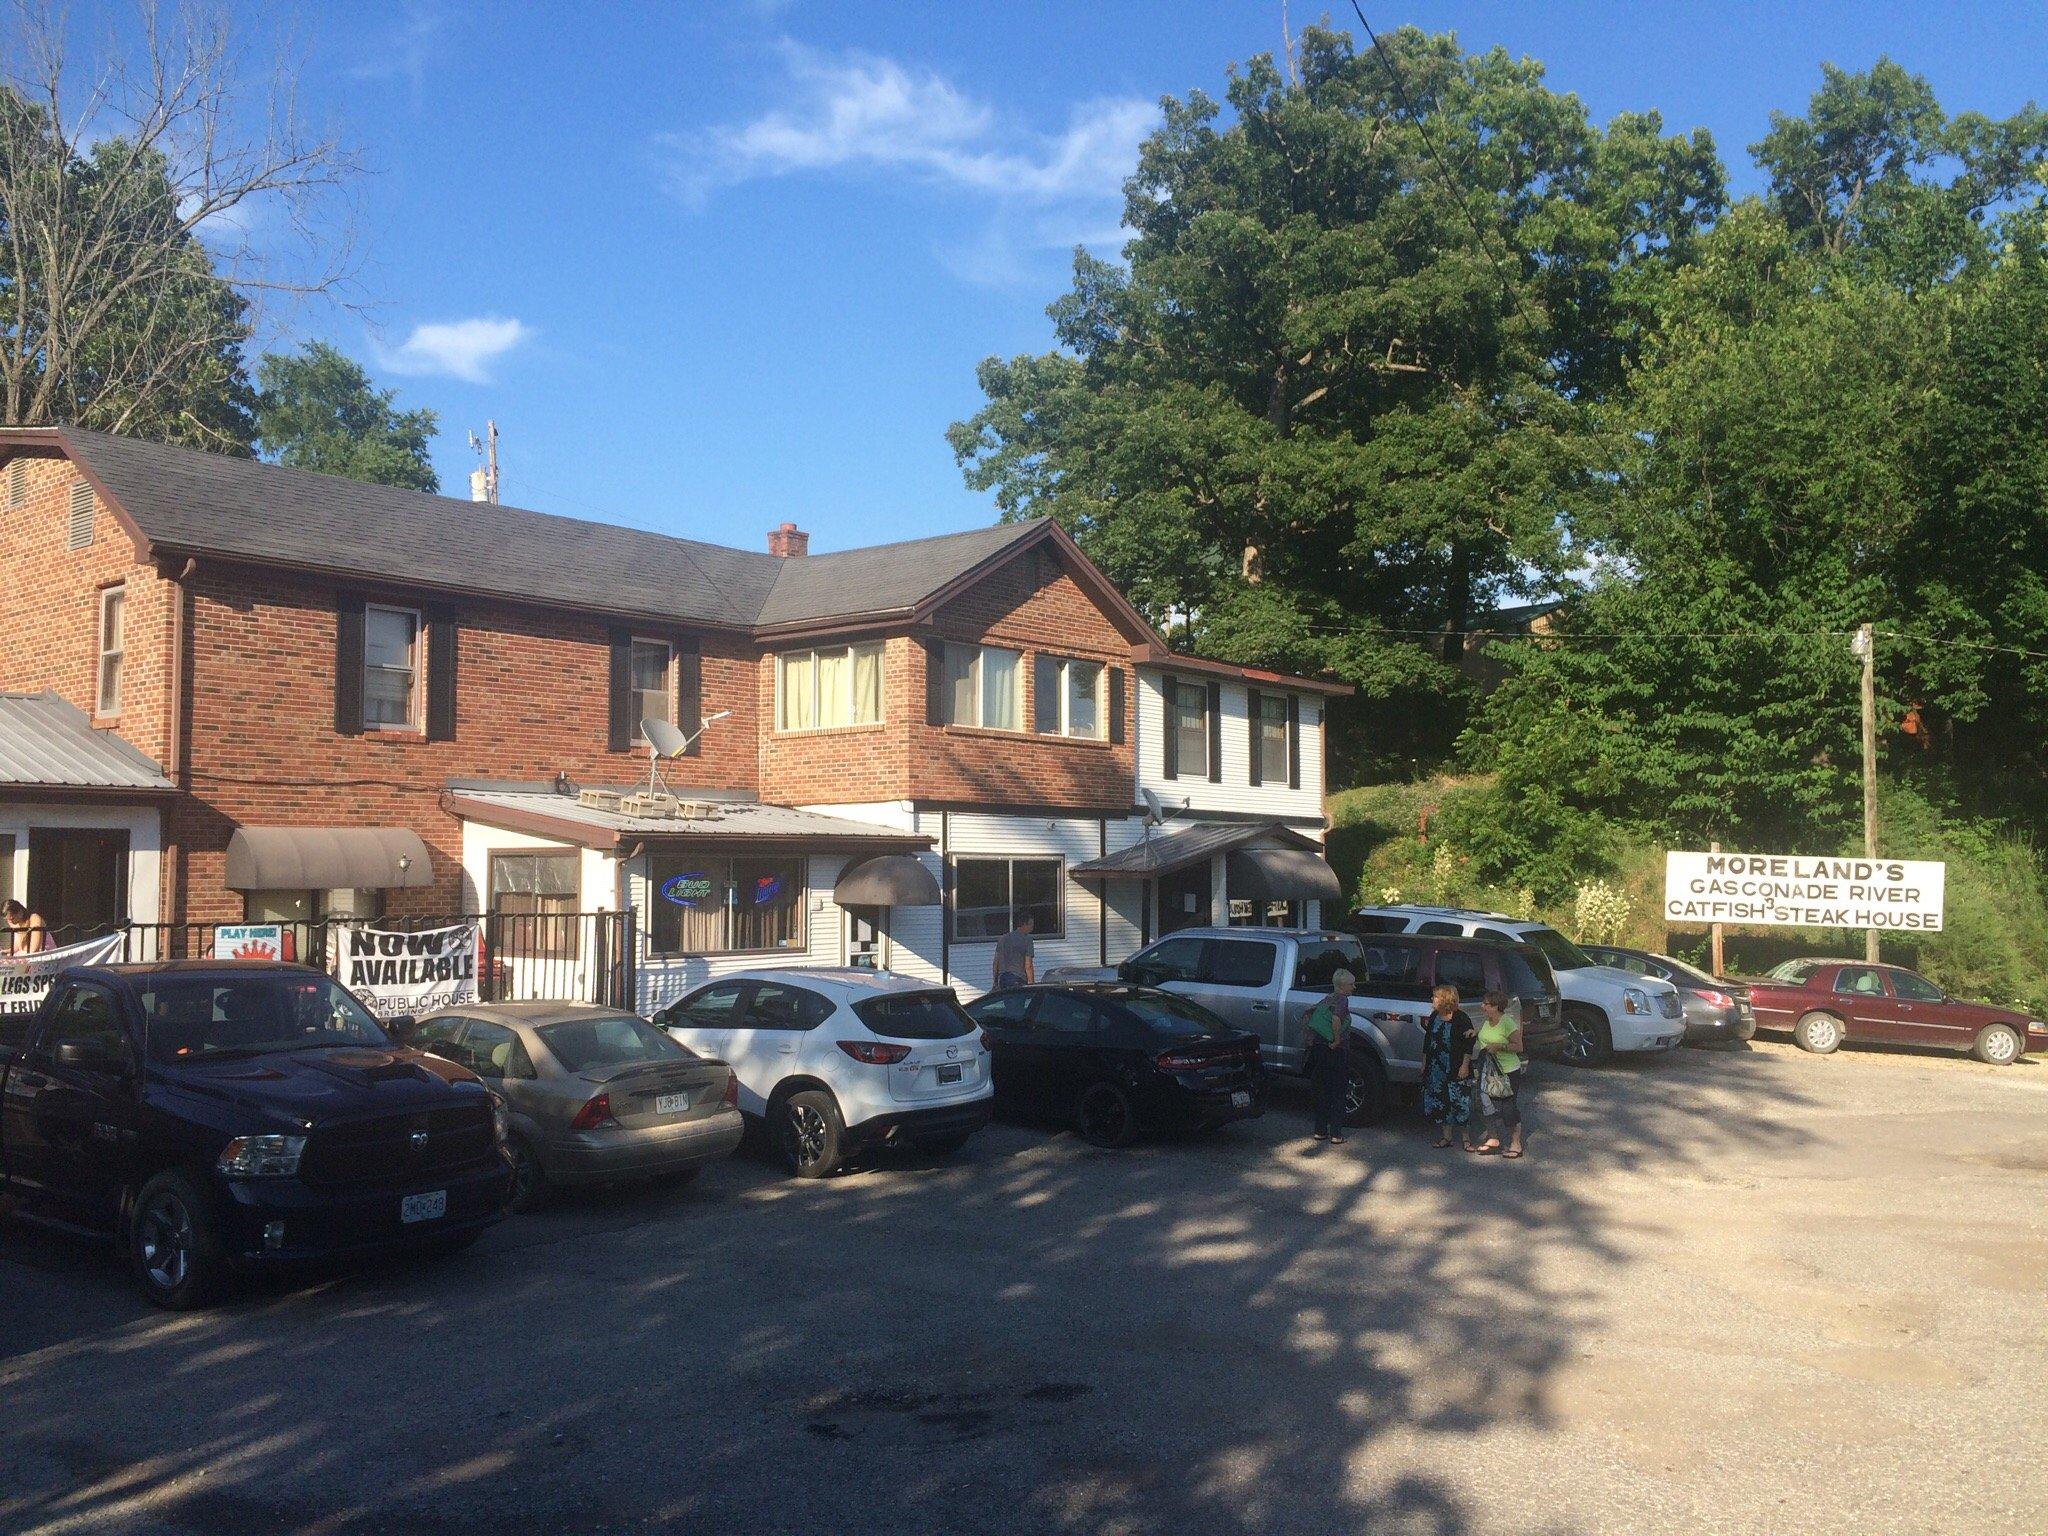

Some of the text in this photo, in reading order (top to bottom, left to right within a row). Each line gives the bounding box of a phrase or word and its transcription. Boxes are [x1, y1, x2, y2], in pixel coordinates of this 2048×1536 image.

[1706, 856, 1905, 881] MORELAND'S
[668, 888, 711, 898] LIGHT
[676, 880, 710, 889] BUD
[1690, 878, 1921, 903] GASCONADE RIVER
[1668, 900, 1765, 918] CATFISH
[1774, 906, 1850, 924] STEAK
[1855, 909, 1939, 929] HOUSE
[221, 928, 247, 938] PLAY
[350, 930, 447, 957] NOW
[350, 954, 474, 985] AVAILABLE
[1, 975, 31, 995] LEGS
[378, 991, 475, 1011] PUBLIC HOUSE
[378, 1008, 424, 1017] BREWING
